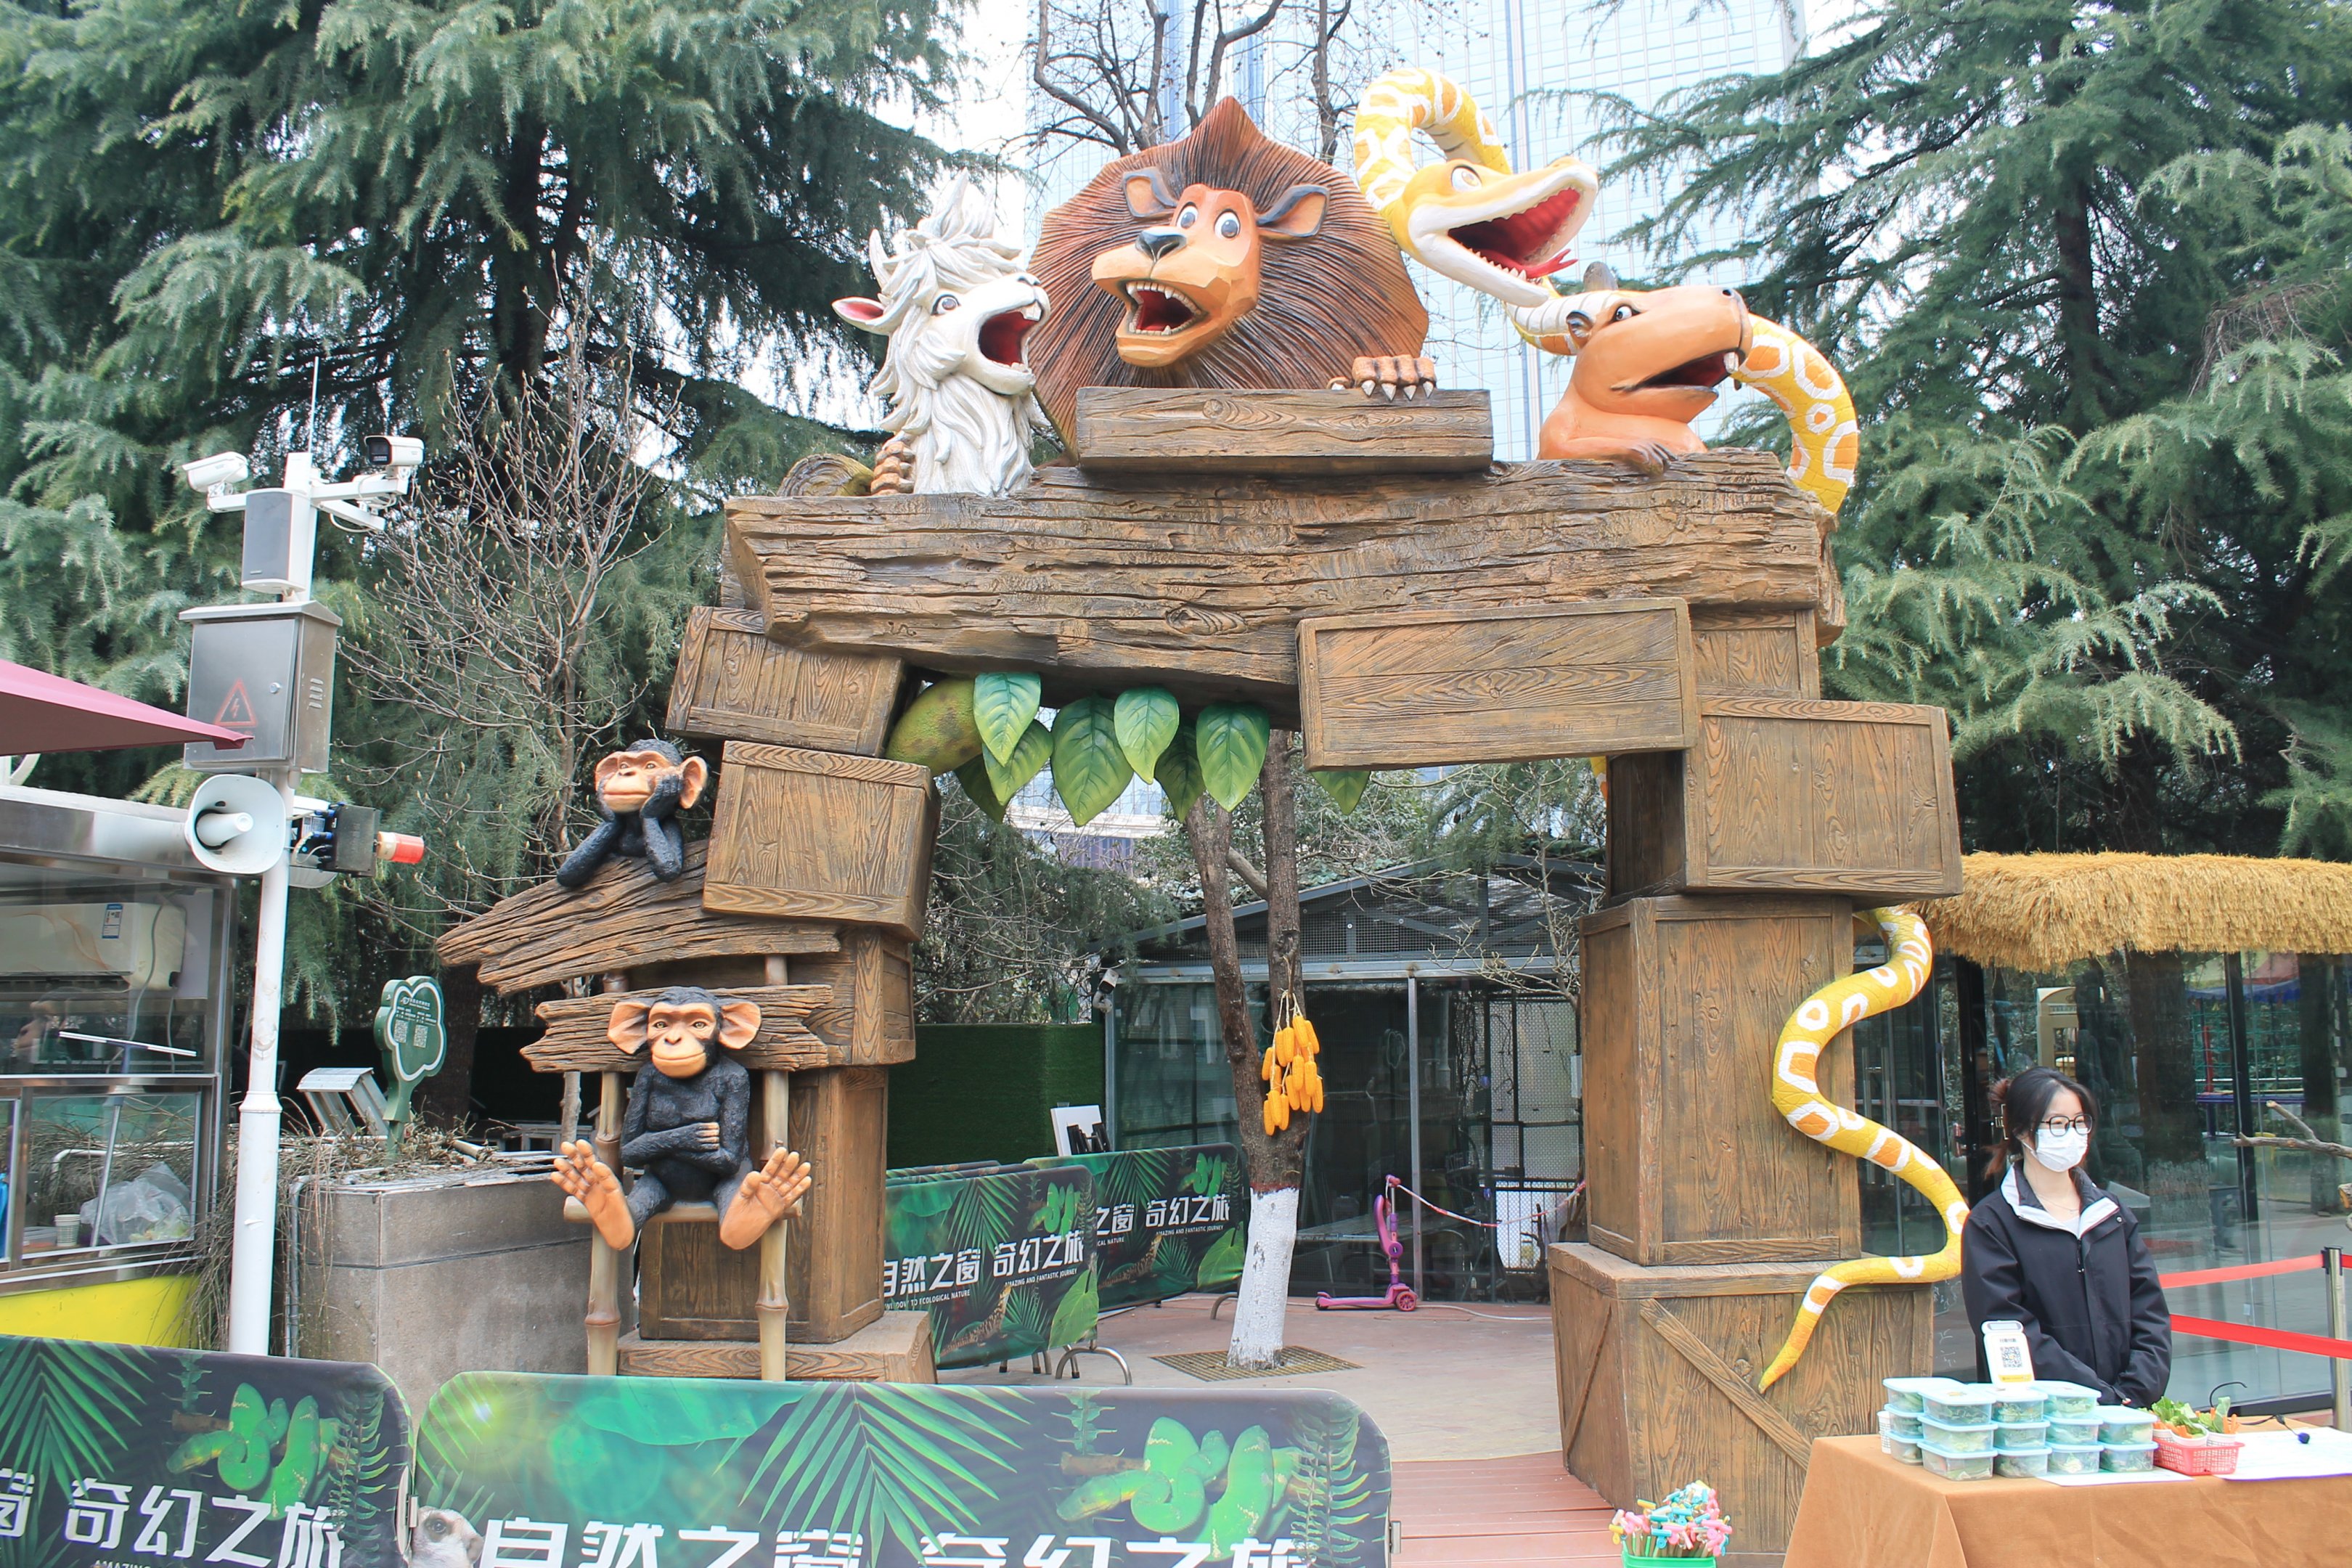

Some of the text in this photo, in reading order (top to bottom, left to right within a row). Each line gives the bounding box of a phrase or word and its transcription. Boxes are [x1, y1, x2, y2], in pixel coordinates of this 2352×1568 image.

[1146, 1193, 1230, 1228] 奇幻之旅
[1108, 1236, 1124, 1245] NATURE
[992, 1230, 1085, 1278] 奇幻之旅
[1036, 1272, 1058, 1282] FANTASTIC
[1059, 1268, 1077, 1278] JOURNEY
[919, 1293, 950, 1304] ECOLOGICAL
[951, 1289, 971, 1299] NATURE
[64, 1477, 344, 1568] 奇幻之旅
